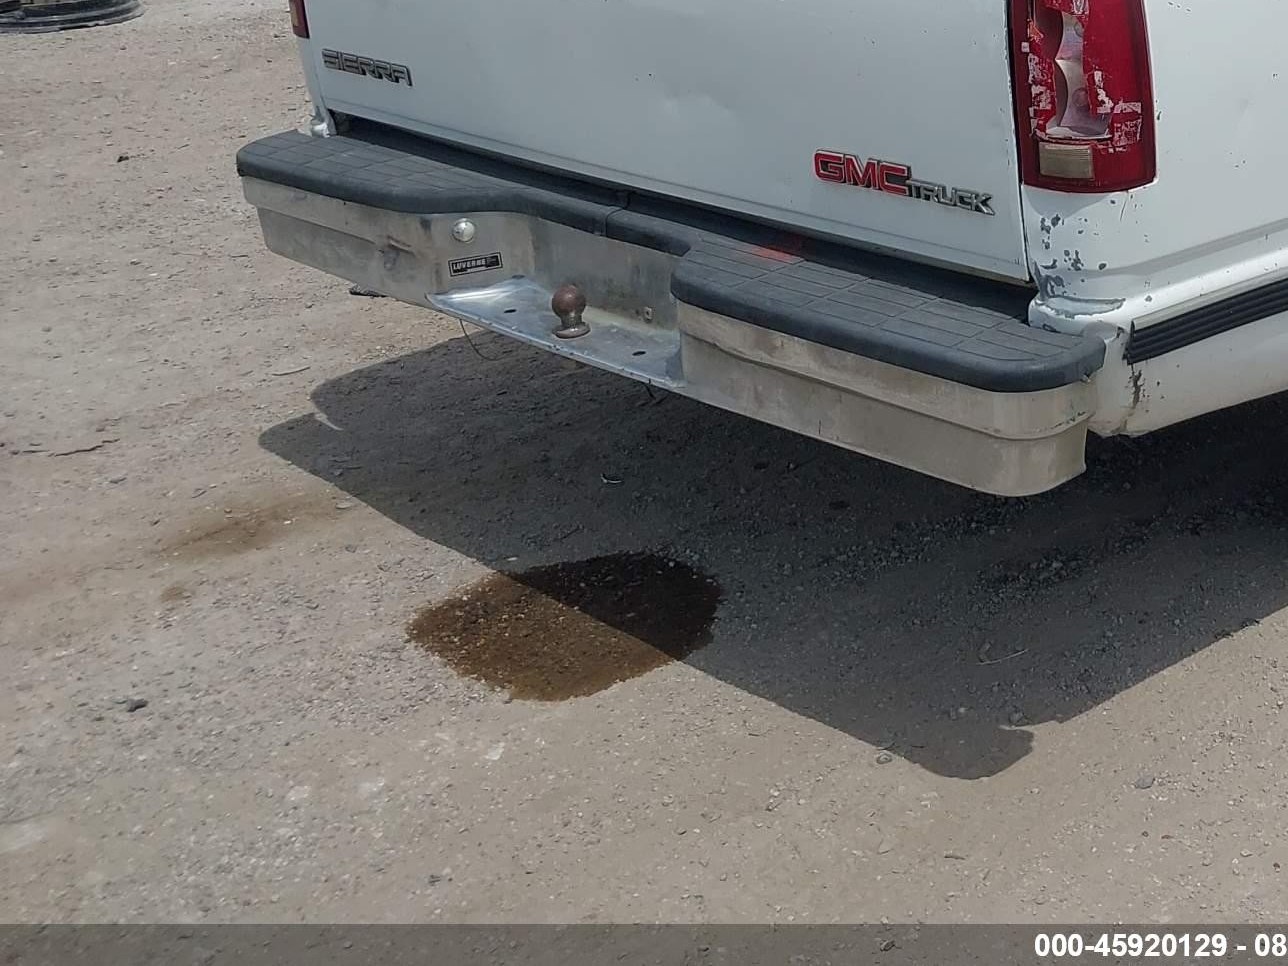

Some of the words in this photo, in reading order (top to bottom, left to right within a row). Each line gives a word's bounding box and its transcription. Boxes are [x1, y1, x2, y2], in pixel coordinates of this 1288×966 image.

[321, 48, 413, 86] SIERRA
[813, 149, 912, 197] GMC
[905, 179, 996, 216] TRUCK
